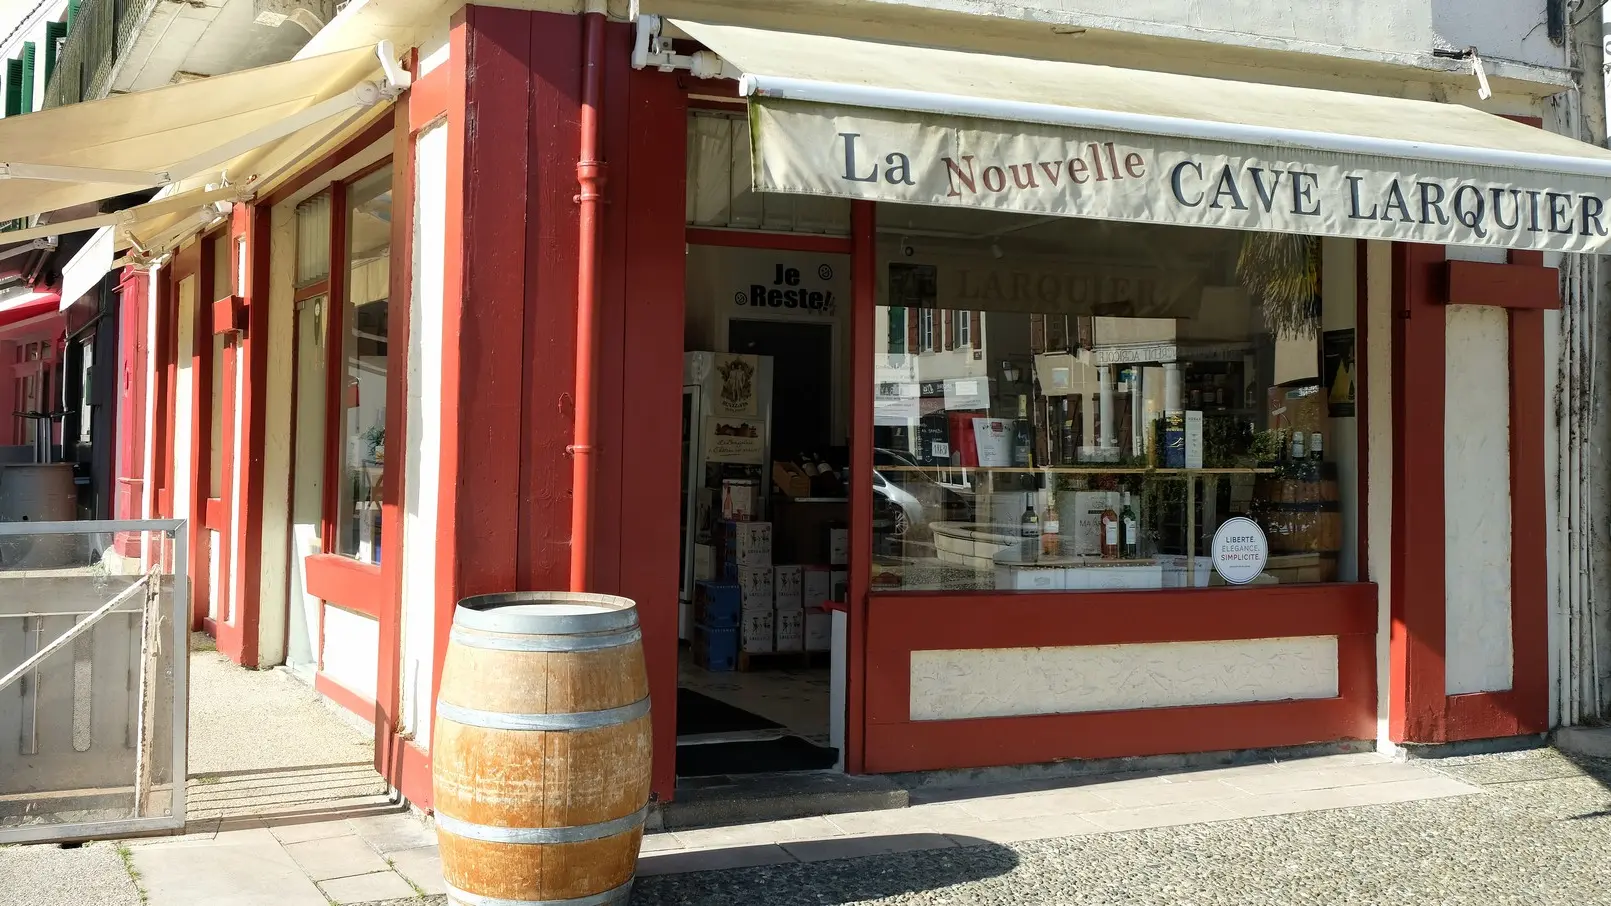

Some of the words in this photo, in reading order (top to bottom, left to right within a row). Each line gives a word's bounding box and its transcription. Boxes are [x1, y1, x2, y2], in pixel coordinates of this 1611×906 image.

[838, 131, 916, 186] La
[941, 141, 1146, 198] Nouvelle
[1170, 159, 1322, 216] CAVE
[1345, 175, 1610, 239] LARQUIER
[773, 263, 800, 286] Je
